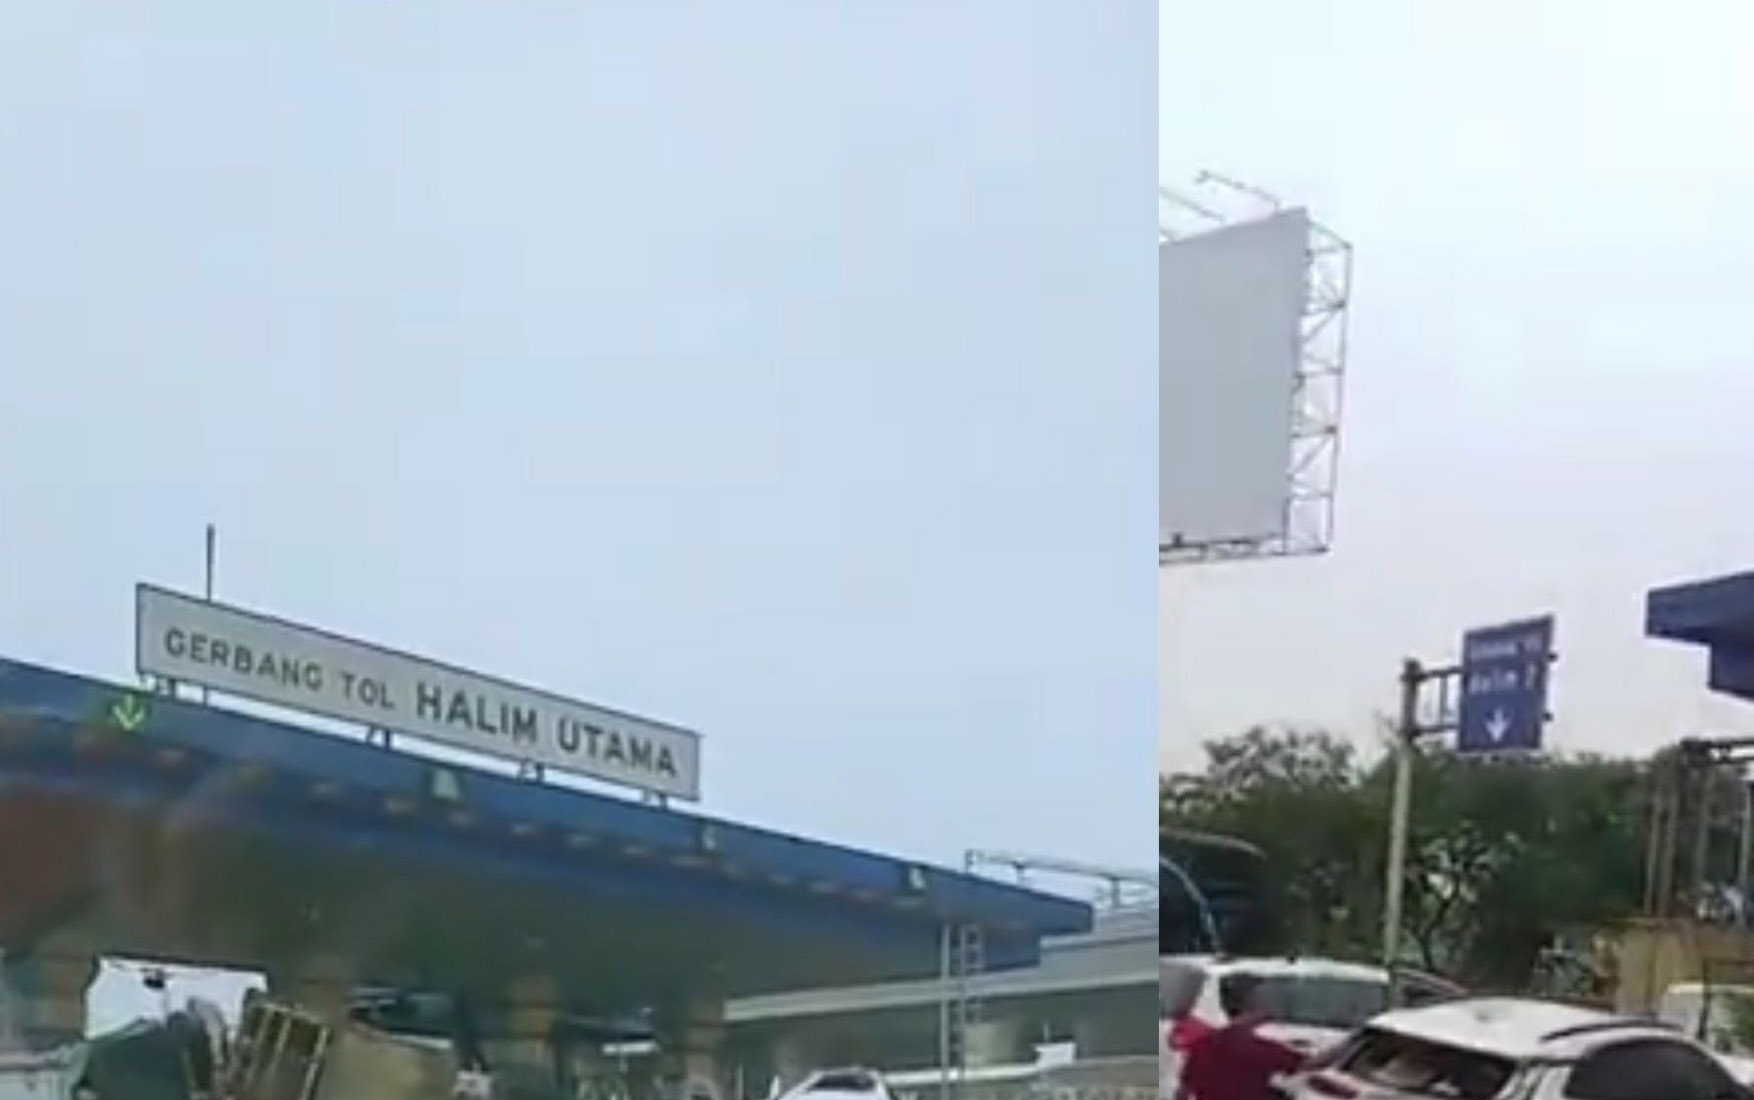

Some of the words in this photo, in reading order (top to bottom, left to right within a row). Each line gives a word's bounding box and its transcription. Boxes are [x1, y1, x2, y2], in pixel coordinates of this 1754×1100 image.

[165, 627, 324, 692] GERBANG
[340, 672, 395, 711] TOL
[417, 683, 538, 745] HALIM
[556, 717, 677, 779] UTAMA
